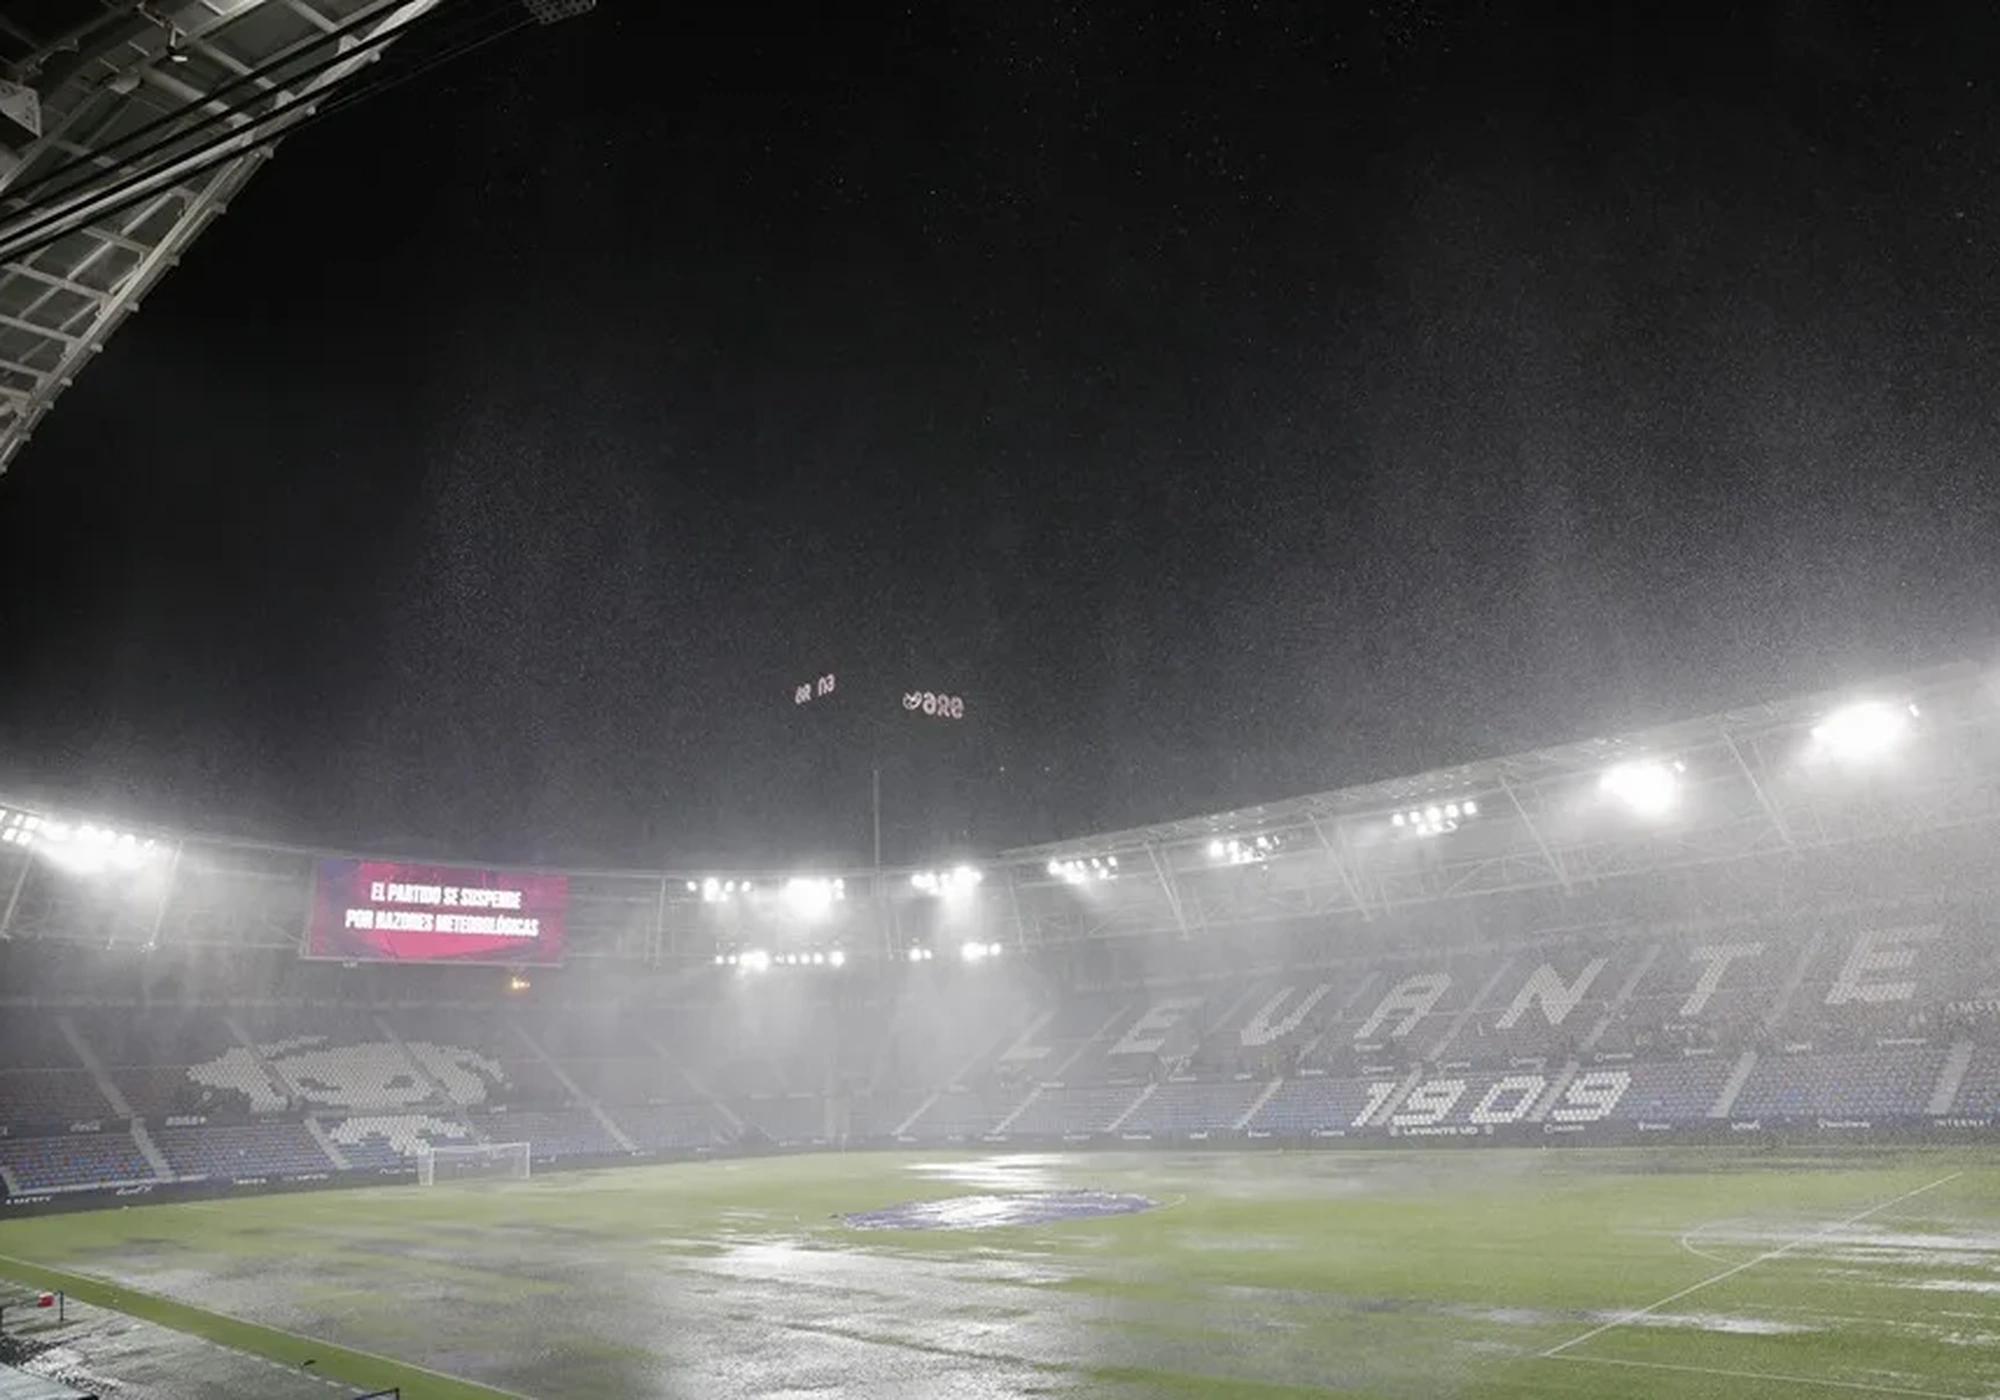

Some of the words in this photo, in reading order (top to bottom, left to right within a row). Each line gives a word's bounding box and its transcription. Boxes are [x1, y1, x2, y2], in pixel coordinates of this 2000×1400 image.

[371, 882, 385, 901] EL
[387, 884, 441, 905] PARTIDO
[443, 887, 460, 905] SE
[460, 888, 521, 909] SUSPENDE
[345, 909, 373, 930] POR
[375, 911, 434, 932] RAZONES
[1351, 1070, 1632, 1127] 1909
